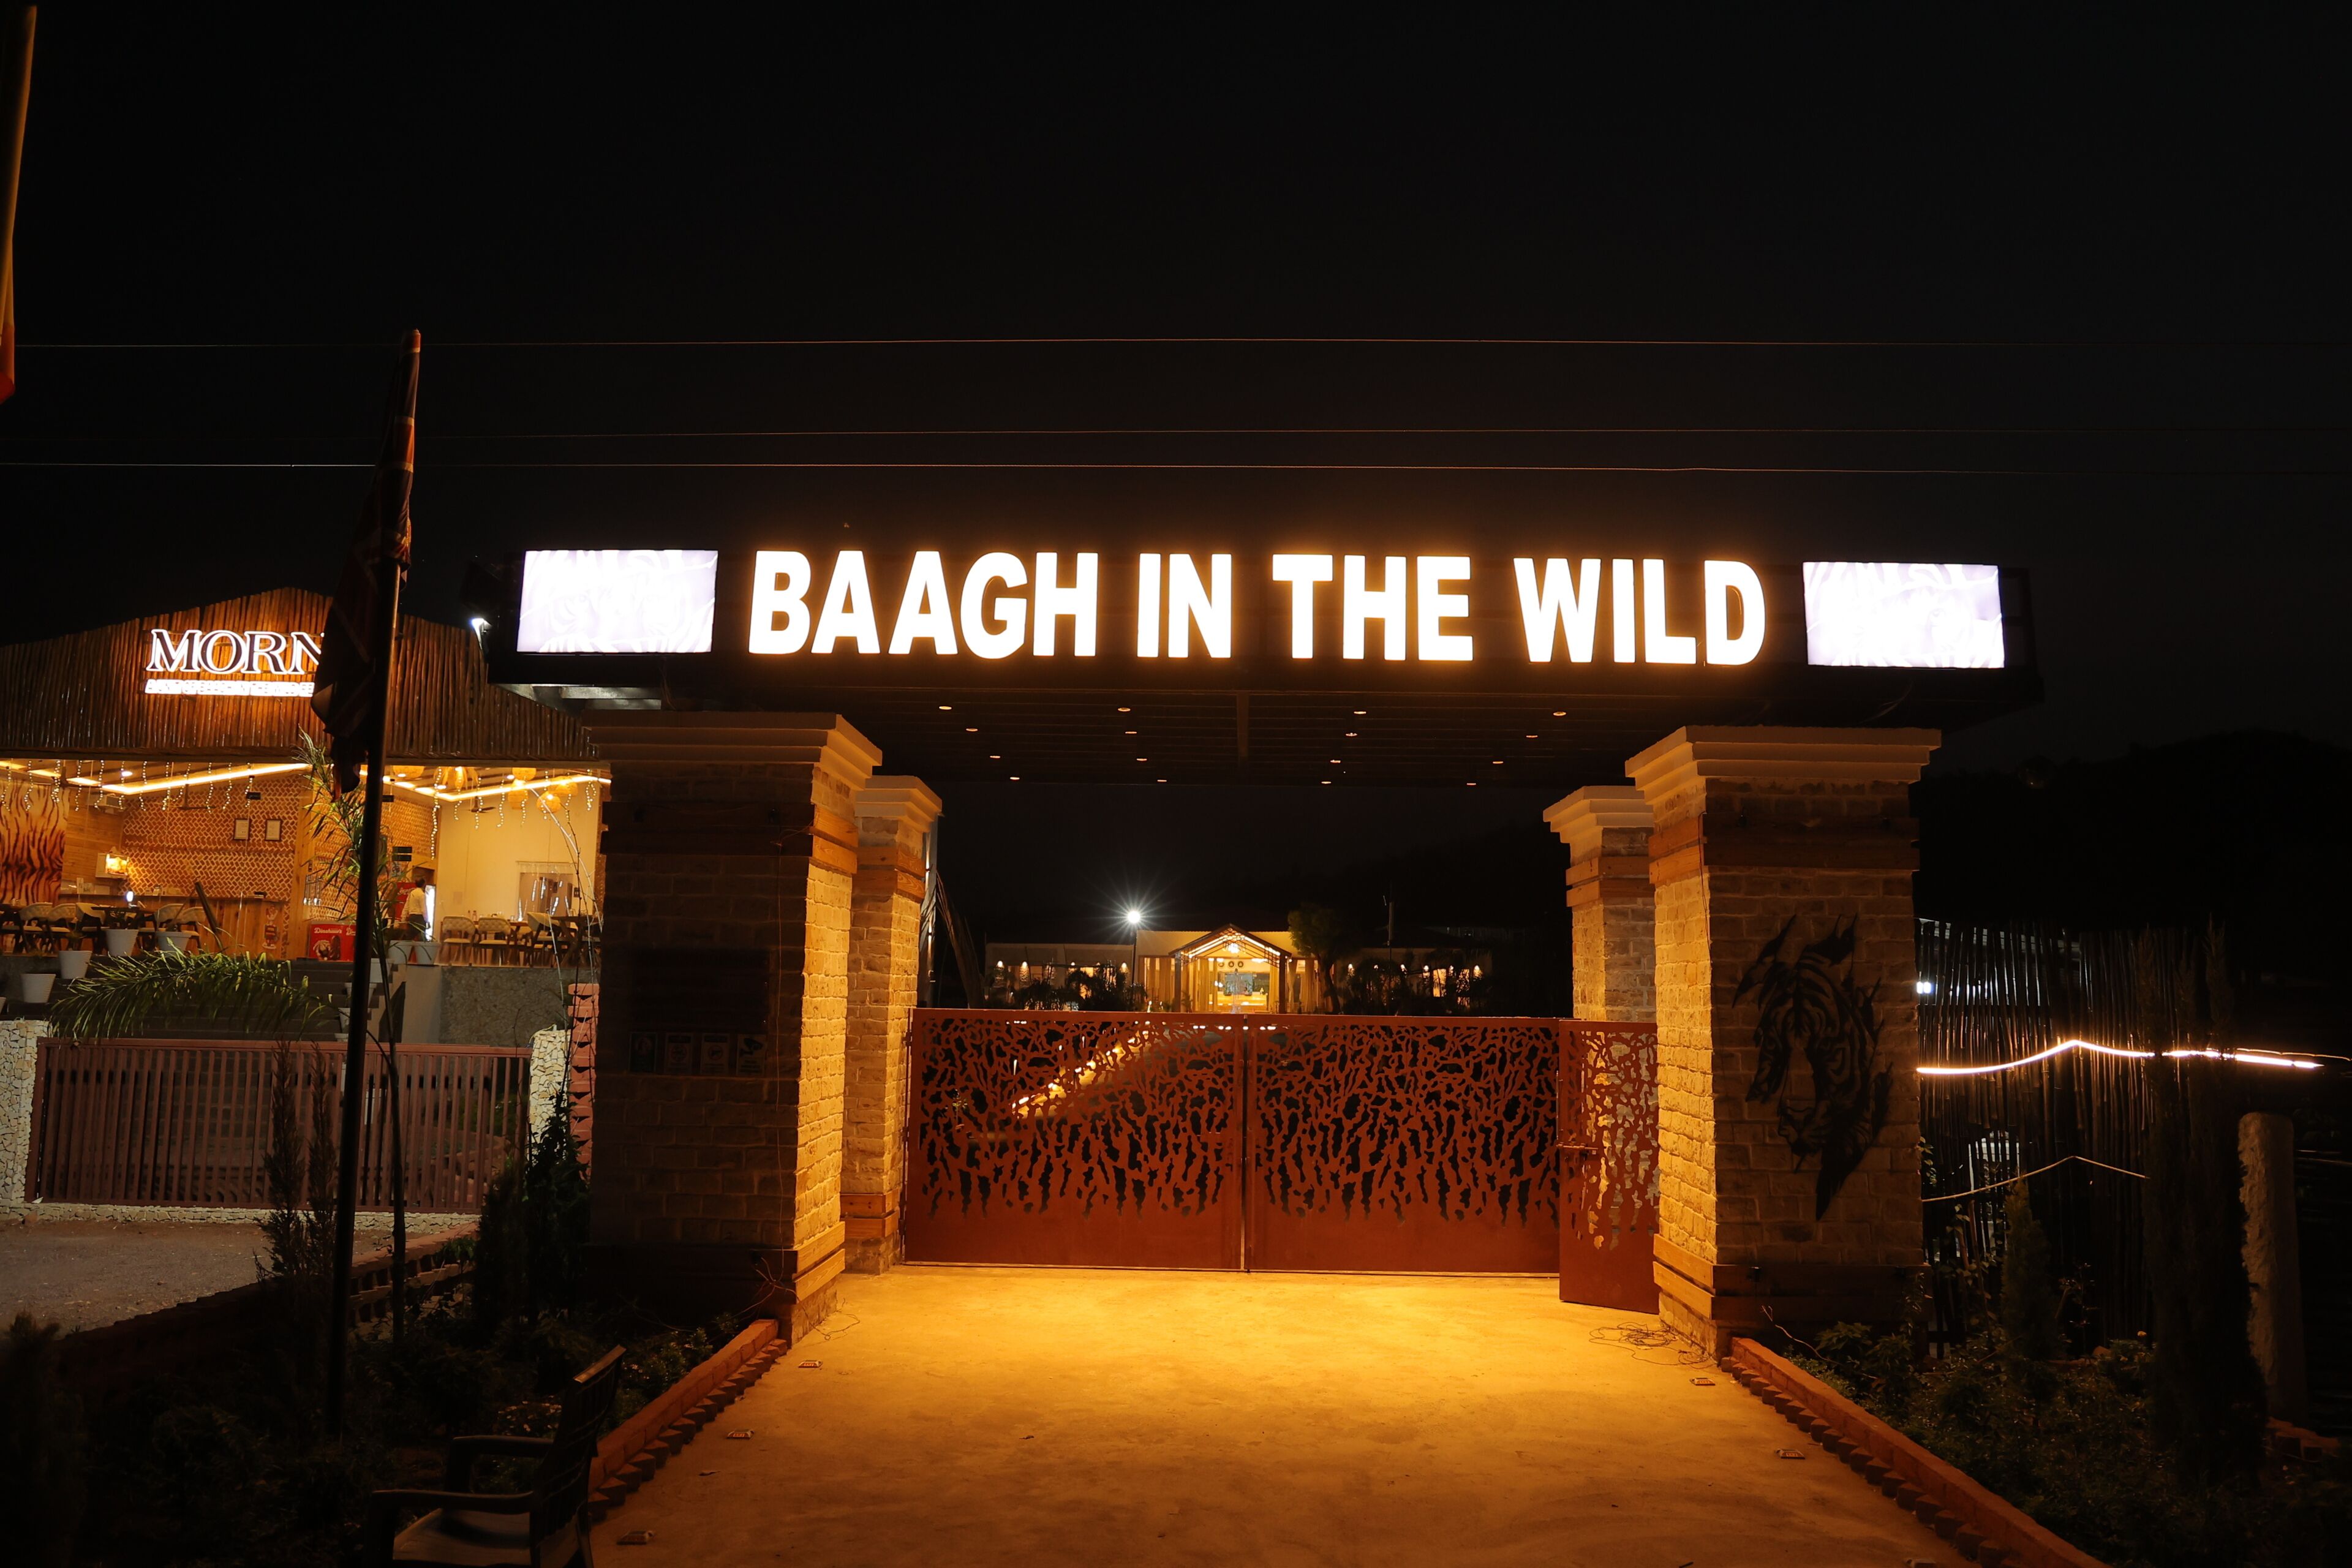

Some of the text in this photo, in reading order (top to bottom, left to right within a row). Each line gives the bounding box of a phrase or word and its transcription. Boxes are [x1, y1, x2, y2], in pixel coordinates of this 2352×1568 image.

[748, 550, 1766, 665] BAAGH IN THE WILD
